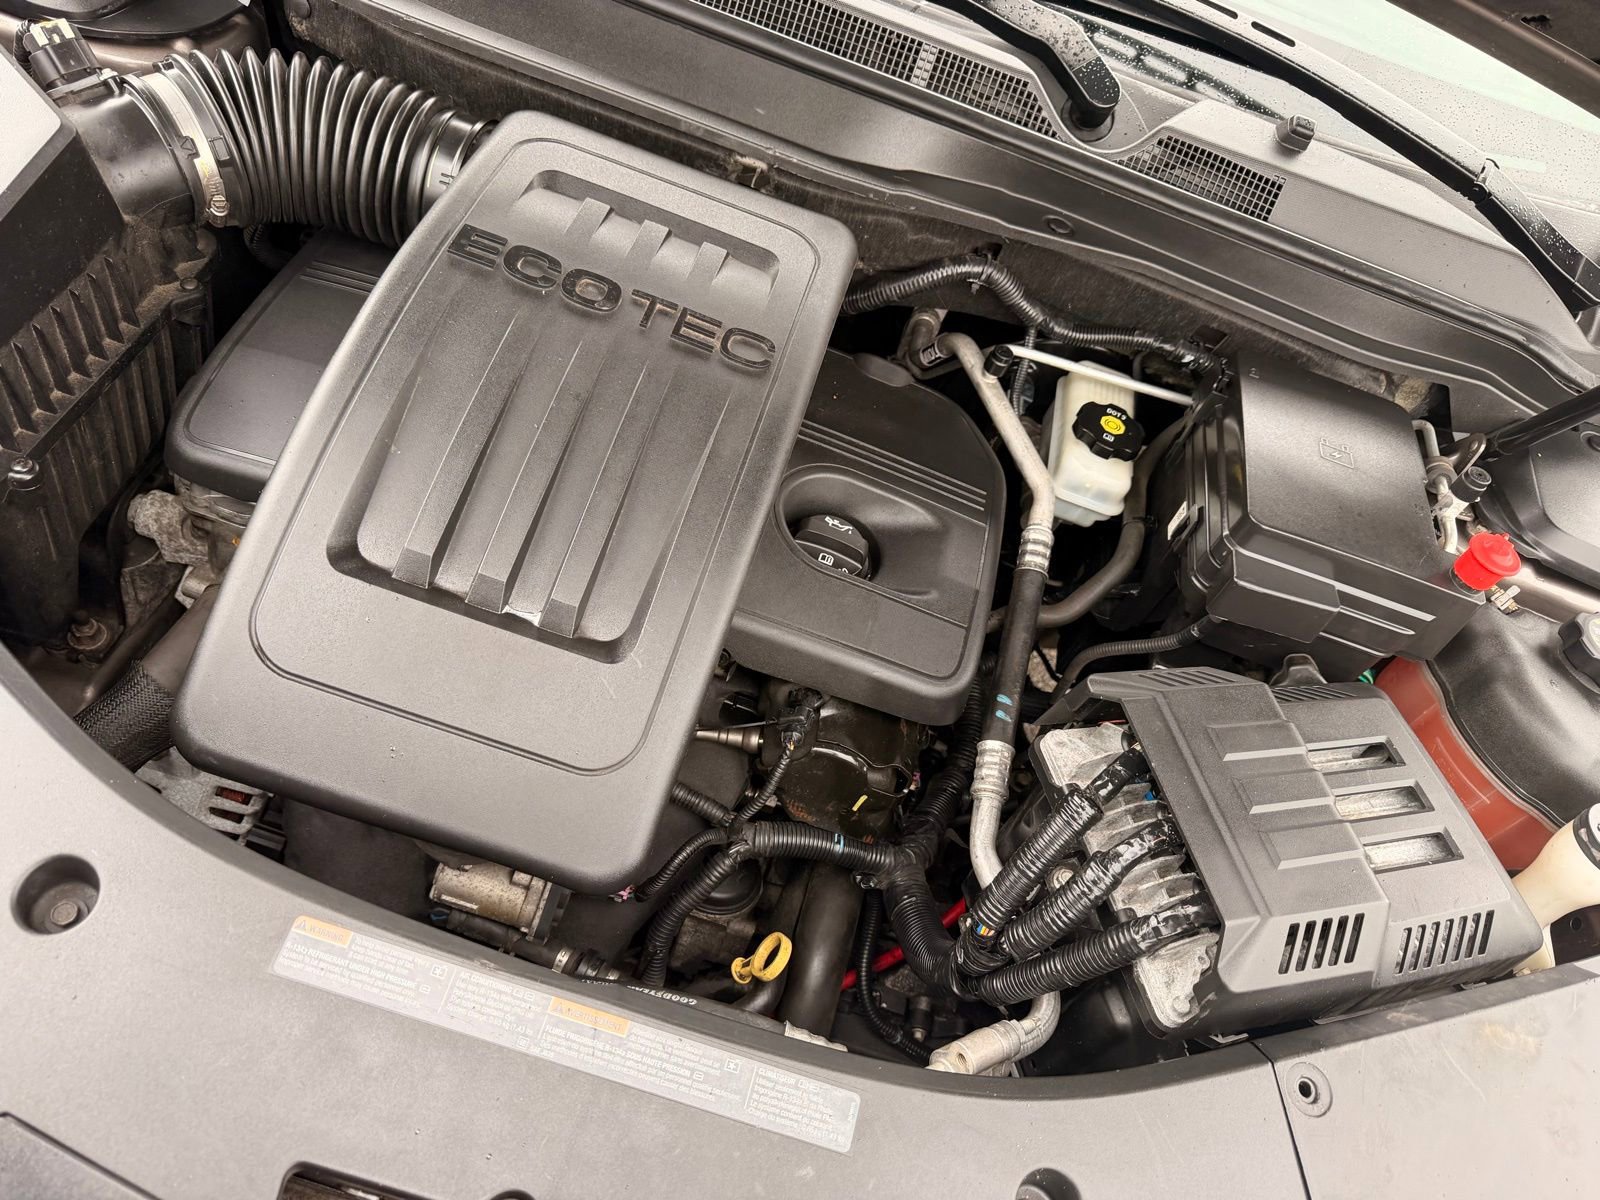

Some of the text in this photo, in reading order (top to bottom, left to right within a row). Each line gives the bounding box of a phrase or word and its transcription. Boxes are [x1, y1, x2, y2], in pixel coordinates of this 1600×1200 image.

[449, 223, 775, 370] ECOTEC
[1106, 407, 1122, 418] DOT
[308, 924, 344, 941] WARNING
[661, 1062, 691, 1076] PRESSION
